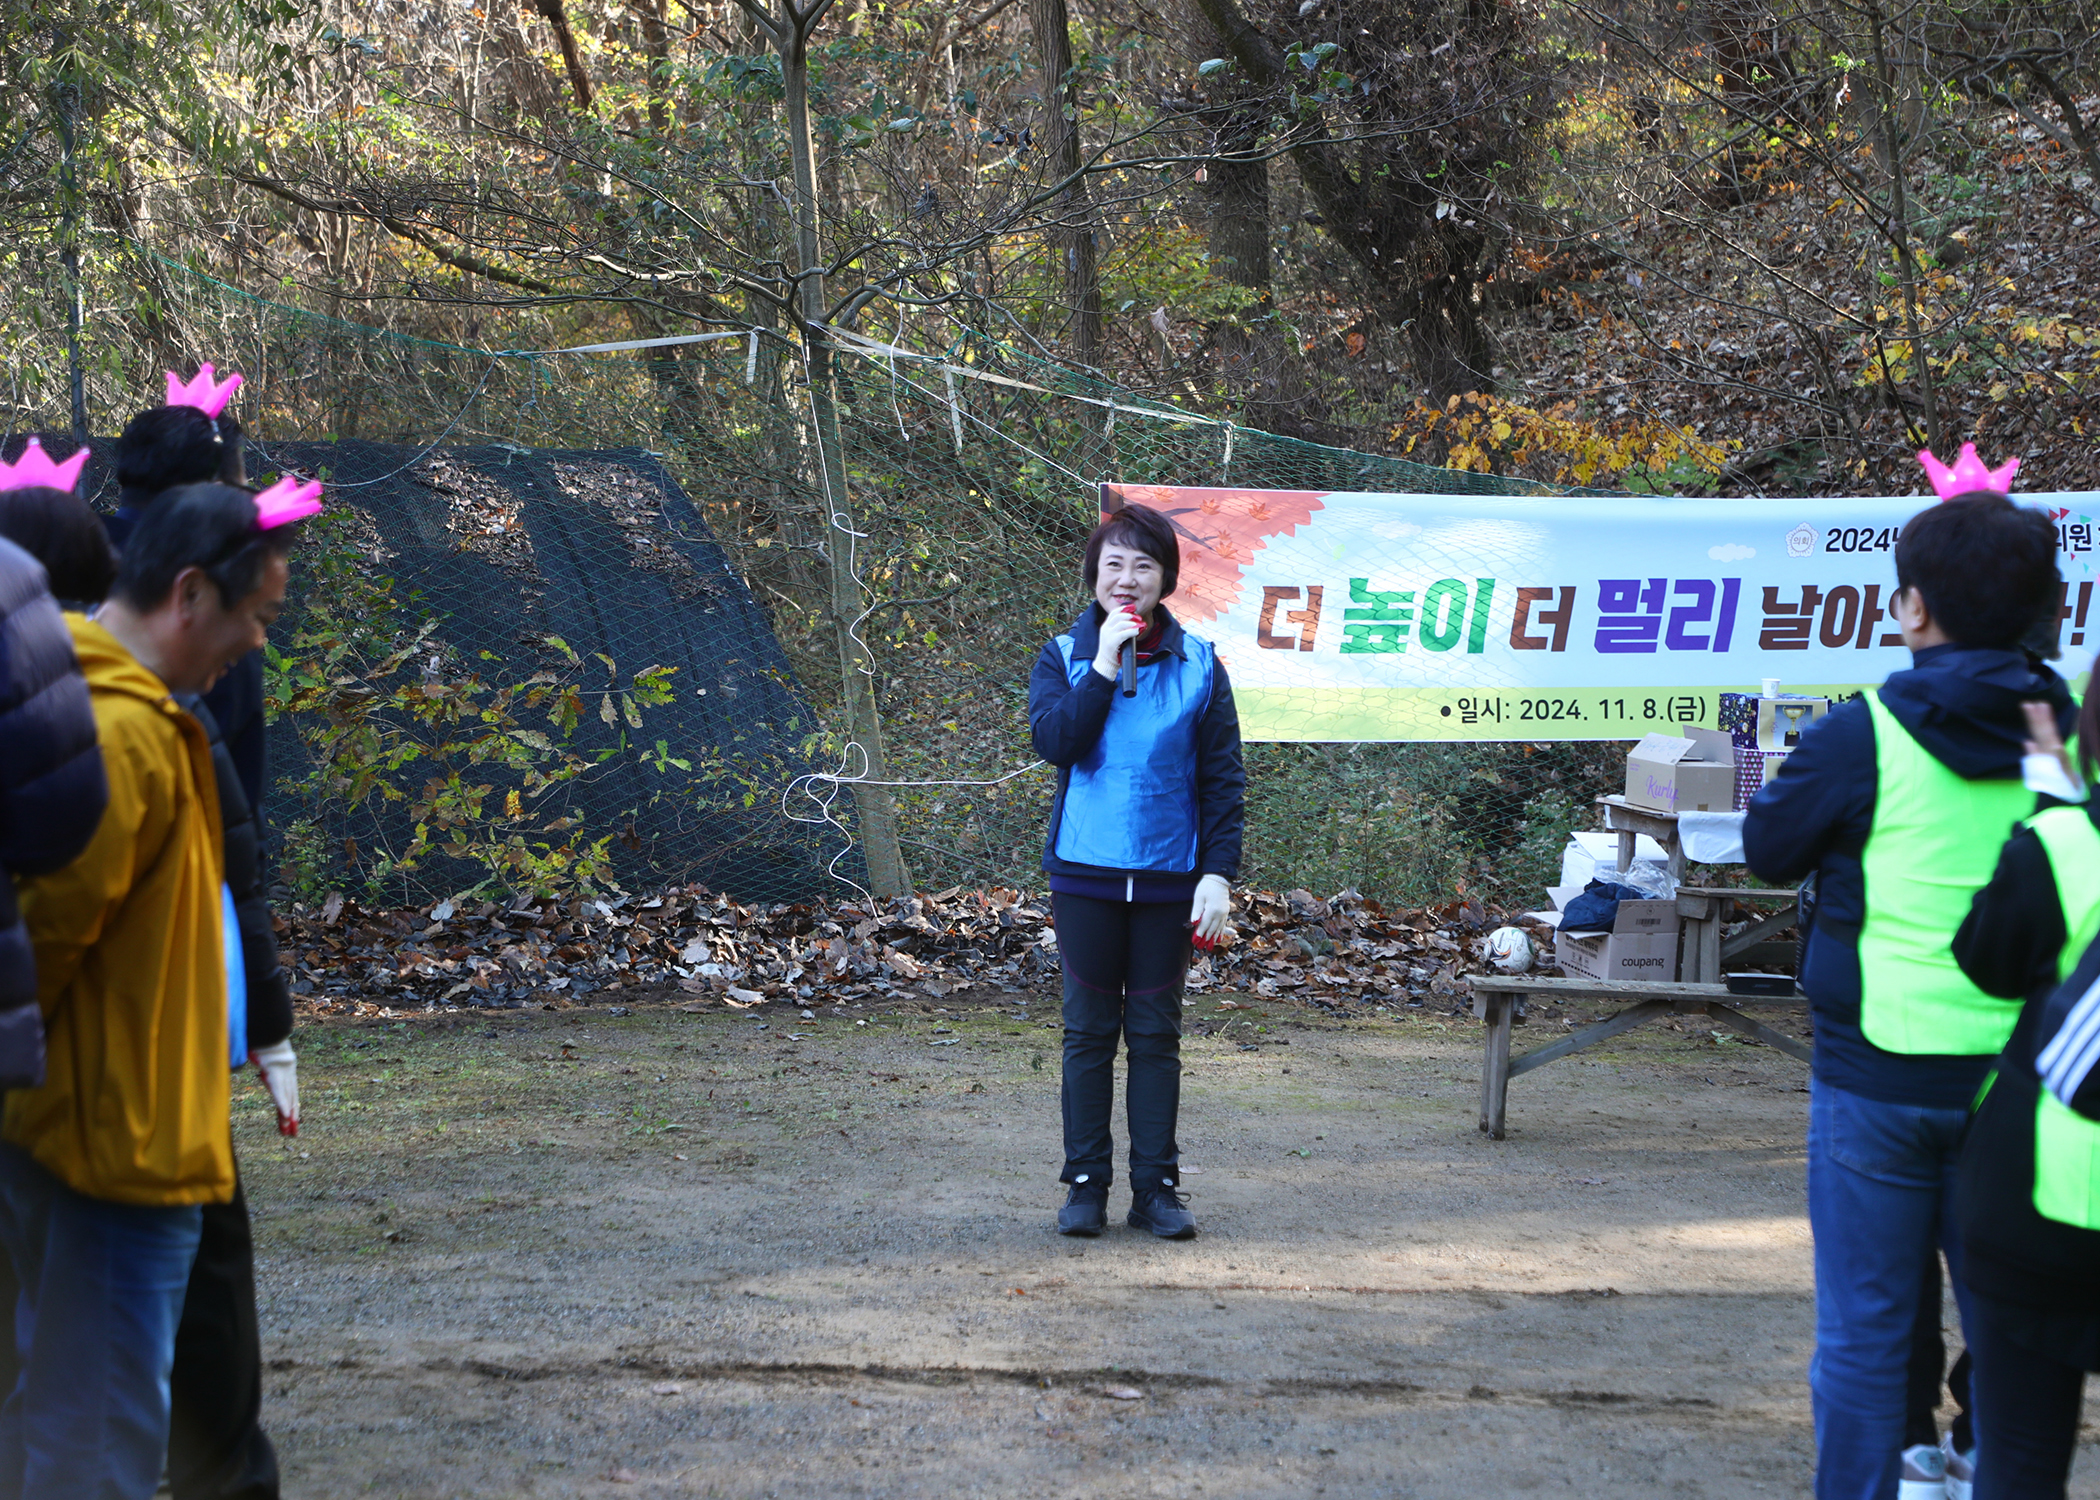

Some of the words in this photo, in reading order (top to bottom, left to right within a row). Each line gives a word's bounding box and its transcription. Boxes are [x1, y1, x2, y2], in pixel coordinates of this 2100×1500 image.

[1257, 585, 1324, 652] 더
[1339, 578, 1496, 654] 높이
[1509, 586, 1576, 652] 더
[1594, 578, 1742, 653] 멀리
[1457, 697, 1511, 723] 일시:
[1519, 698, 1588, 722] 2024.
[1598, 698, 1634, 721] 11.
[1643, 695, 1706, 724] 8.(금)
[1646, 775, 1680, 808] Kurly
[1621, 957, 1665, 969] coupang
